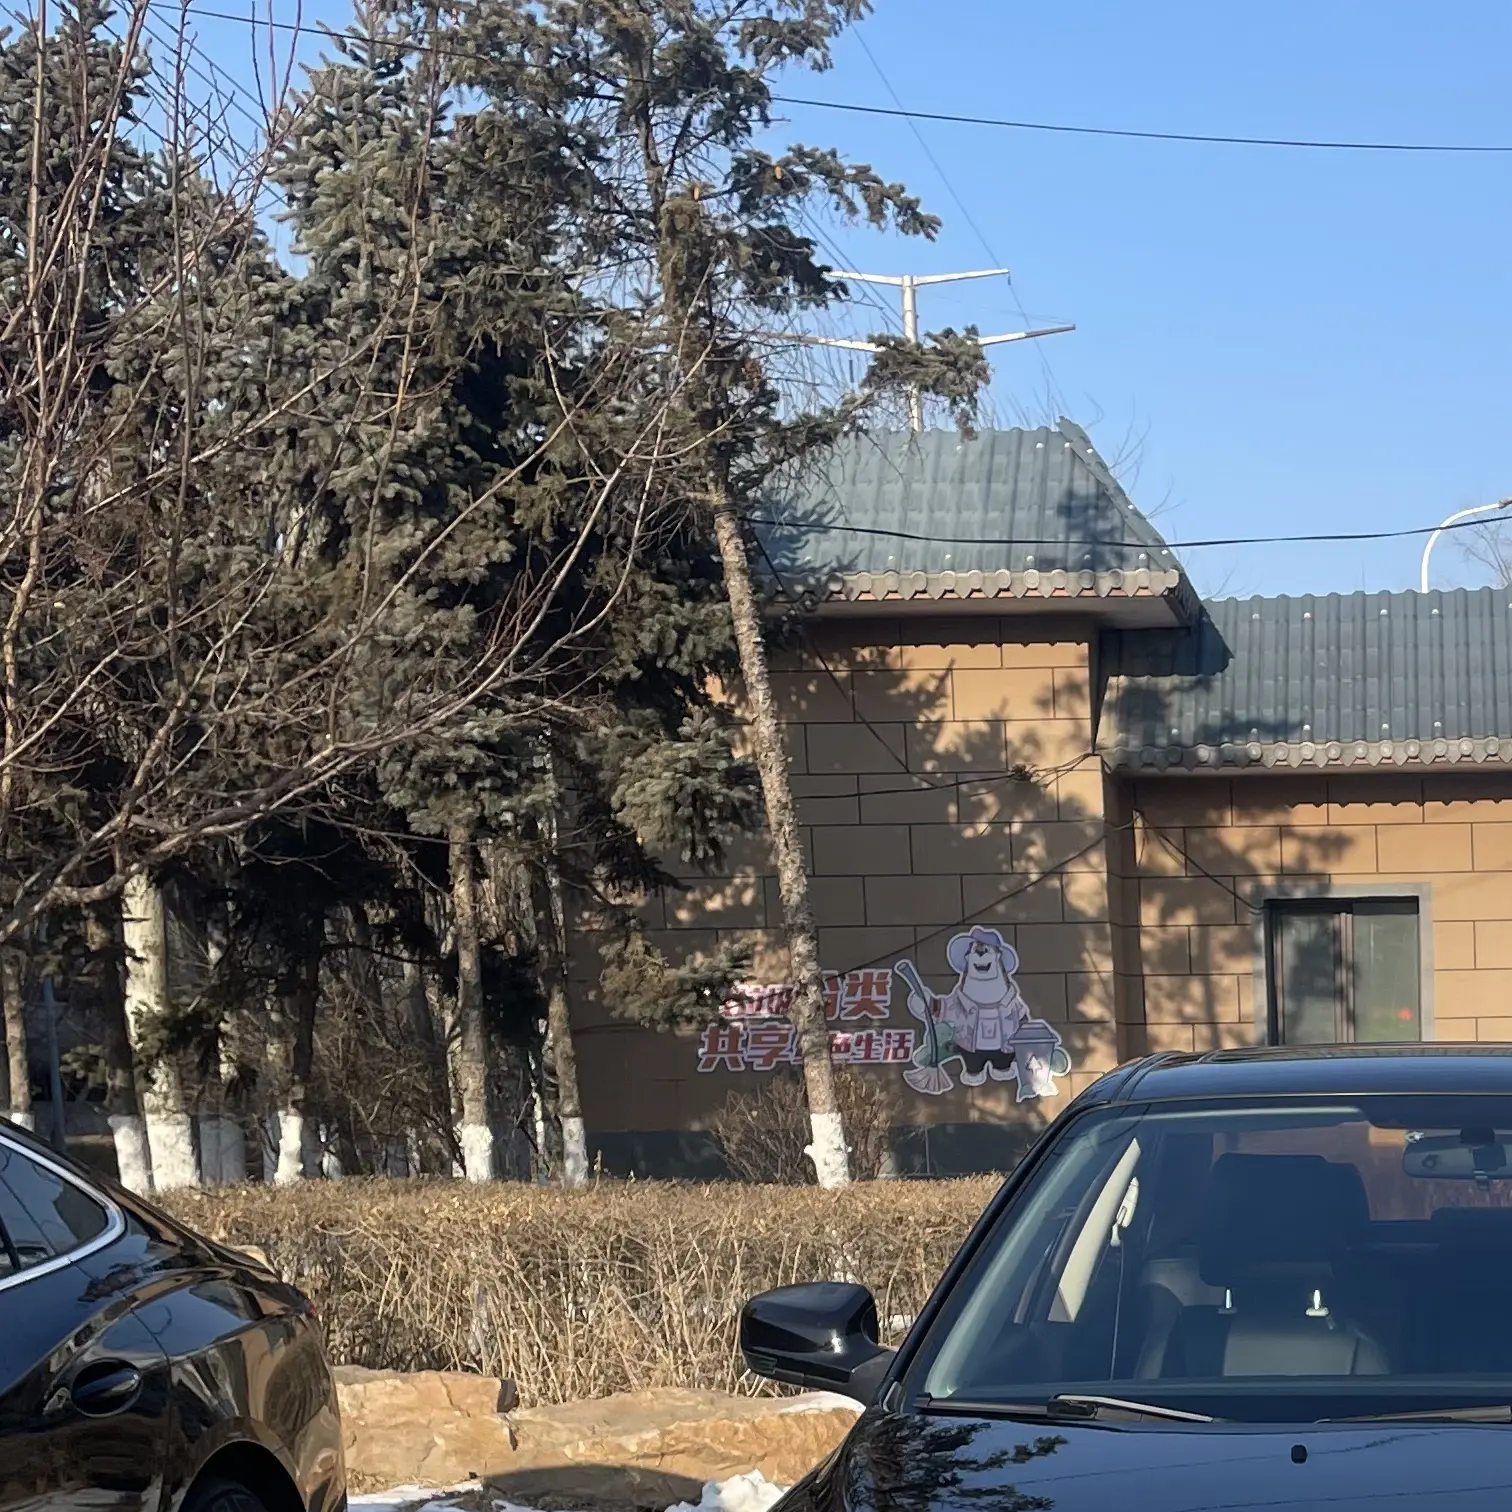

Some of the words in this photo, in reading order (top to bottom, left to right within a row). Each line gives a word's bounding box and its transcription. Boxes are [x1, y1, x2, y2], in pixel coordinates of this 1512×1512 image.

[698, 1022, 914, 1072] 共享色生活
